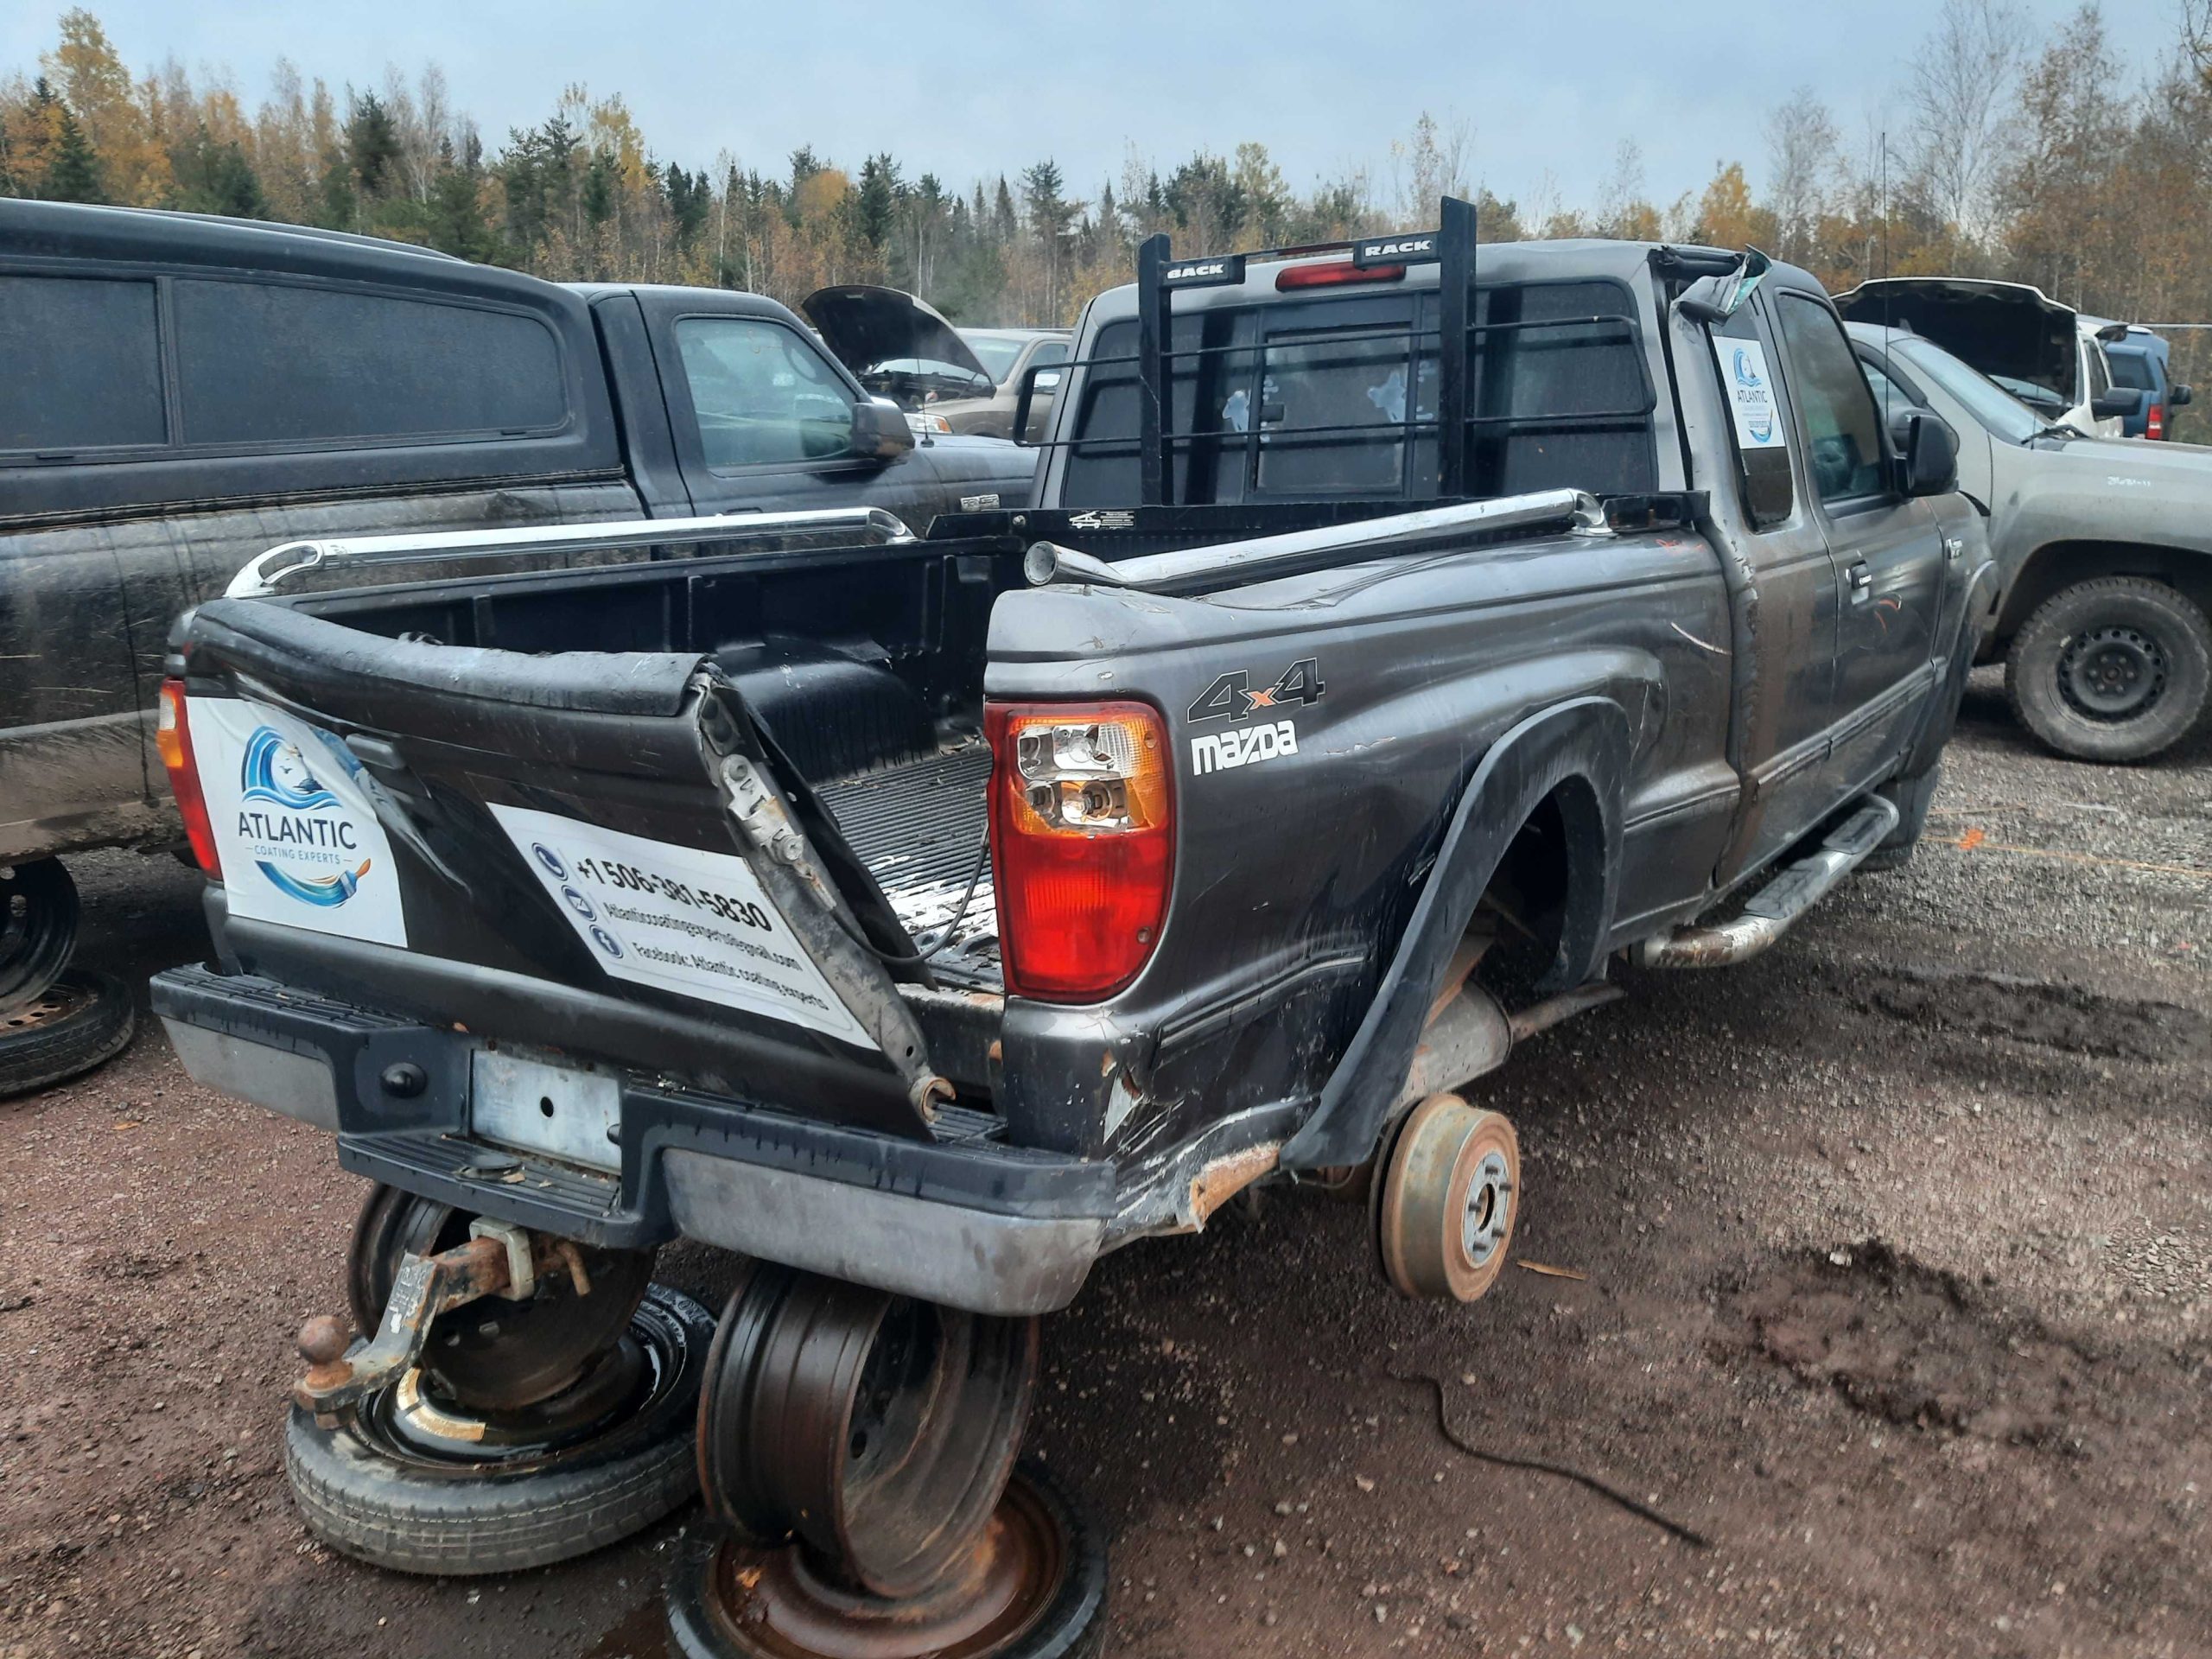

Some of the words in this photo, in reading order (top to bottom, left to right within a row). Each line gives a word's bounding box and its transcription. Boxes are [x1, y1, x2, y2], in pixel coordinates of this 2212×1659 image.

[1365, 240, 1433, 257] RACK
[1167, 264, 1224, 278] BACK
[1737, 390, 1768, 404] ATLANTIC
[1187, 658, 1325, 723] 4x4
[238, 811, 357, 849] ATLANTIC
[254, 845, 296, 859] COATING
[298, 850, 341, 865] EXPERTS
[577, 858, 606, 885] +1
[601, 860, 772, 932] 506-381-5830
[632, 942, 693, 968] Facebook:
[691, 954, 741, 978] Atlantic
[738, 969, 786, 996] coating
[781, 984, 830, 1010] experts
